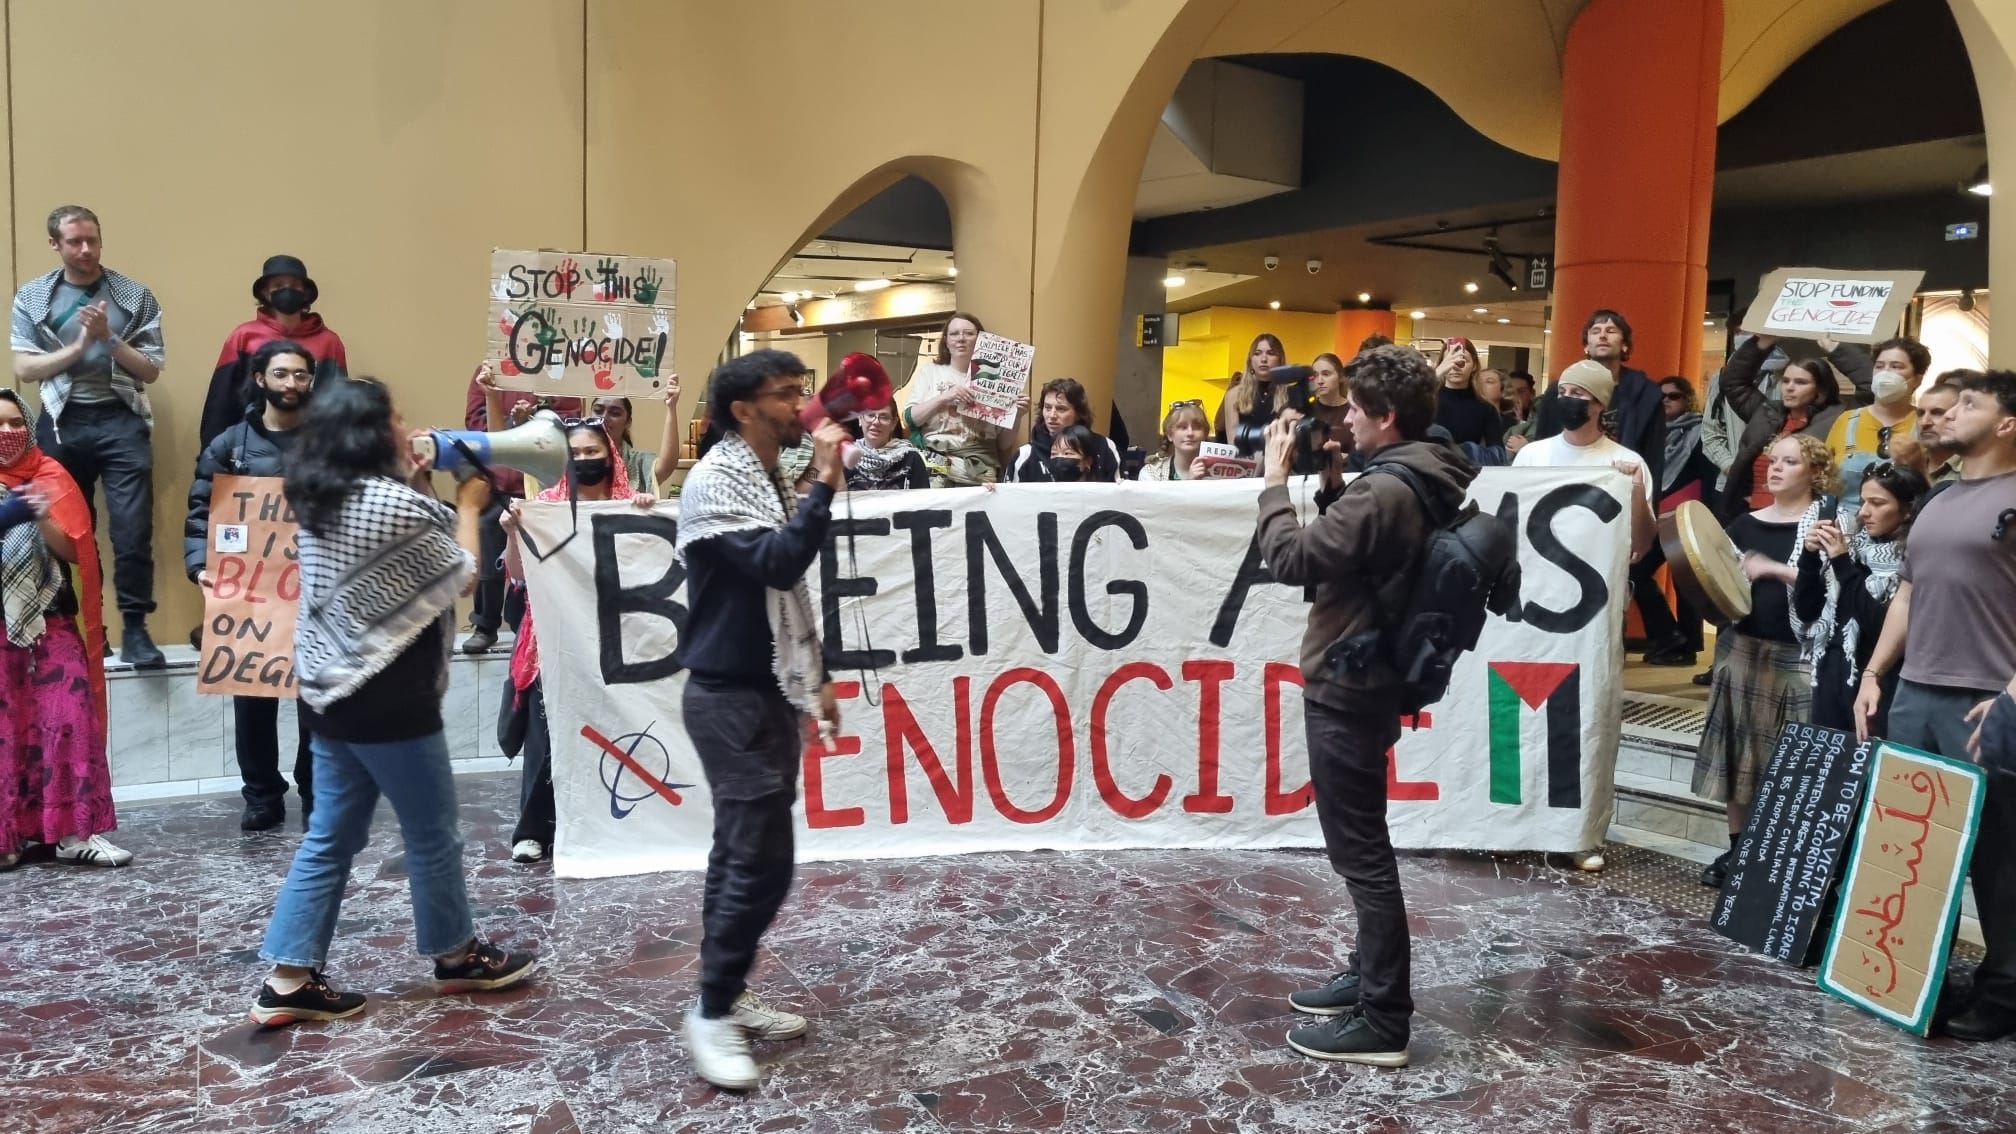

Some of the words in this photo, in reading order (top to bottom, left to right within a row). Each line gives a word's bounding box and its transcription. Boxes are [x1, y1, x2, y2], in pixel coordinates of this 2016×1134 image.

[506, 264, 580, 301] STOP
[597, 267, 649, 303] THIS
[1781, 281, 1830, 298] STOP
[1831, 284, 1891, 298] FUNDING
[1771, 307, 1879, 326] GENOCIDE
[509, 310, 668, 388] GENOCIDE!
[1015, 347, 1028, 358] HAS
[1213, 465, 1242, 477] STOP
[213, 556, 301, 604] BLO
[591, 508, 1149, 686] BEING
[1209, 482, 1622, 648] AS
[212, 613, 273, 643] ON
[801, 659, 1440, 829] ENOCIDE
[1768, 736, 1792, 777] COMMIT
[1786, 740, 1808, 769] PUSH
[1804, 743, 1824, 770] KILL
[1849, 741, 1872, 775] HOW
[1779, 775, 1793, 790] BS
[1803, 745, 1841, 818] REPEATEDLY
[1840, 780, 1859, 800] TO
[1747, 780, 1775, 833] GENOCIDE
[1787, 775, 1812, 825] INNOCENT
[1832, 803, 1851, 824] BE
[1757, 794, 1786, 862] PROPAGANDA
[1792, 820, 1811, 853] BREAK
[1825, 826, 1841, 843] A
[1737, 838, 1753, 866] OVER
[1768, 828, 1791, 884] CIVILIANS
[1798, 810, 1830, 889] ACCORDING
[1730, 871, 1744, 890] 75
[1771, 857, 1798, 925] INTERNATIONAL
[1805, 848, 1837, 908] VICTIM
[1717, 895, 1737, 927] YEARS
[1791, 894, 1806, 912] TO
[1763, 928, 1778, 956] LAWS
[1777, 914, 1800, 960] ISRAEL
